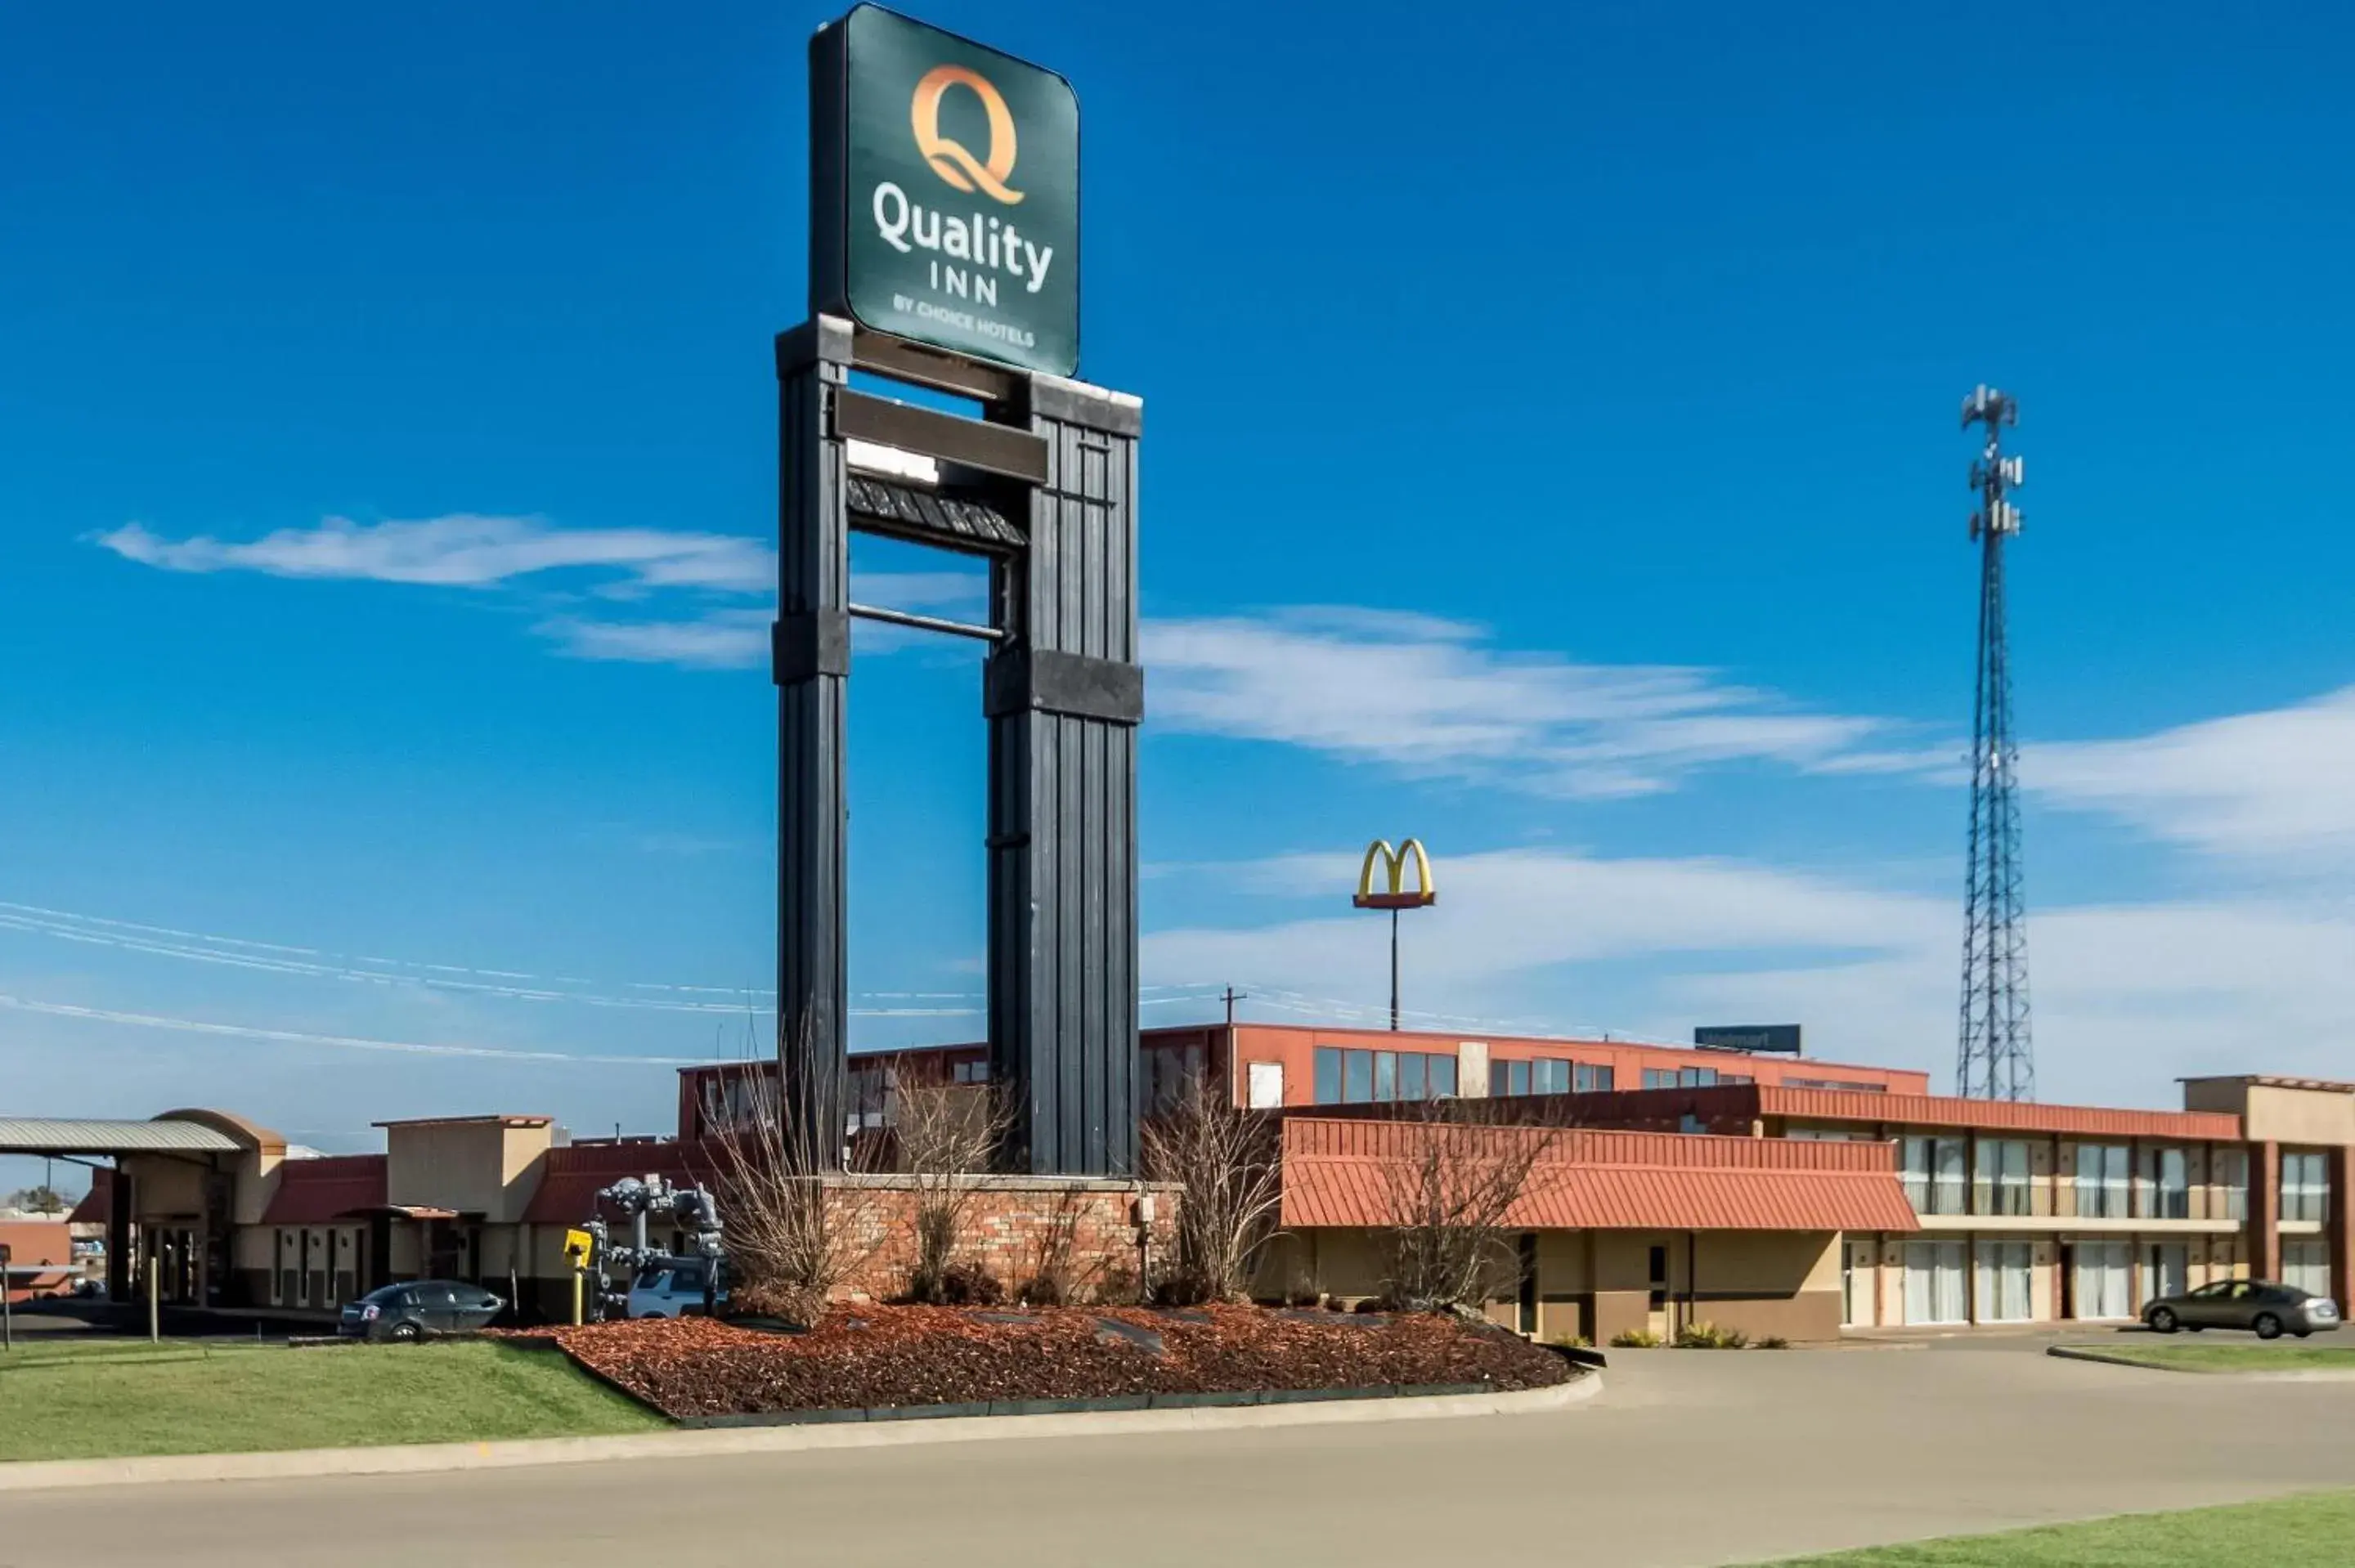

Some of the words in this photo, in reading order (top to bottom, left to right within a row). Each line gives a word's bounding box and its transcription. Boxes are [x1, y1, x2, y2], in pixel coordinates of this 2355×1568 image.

[912, 65, 1025, 204] Q
[872, 181, 1053, 293] Quality
[893, 293, 914, 313] BY
[917, 301, 974, 330] CHOICE
[977, 318, 1035, 348] HOTELS
[930, 261, 997, 307] INN
